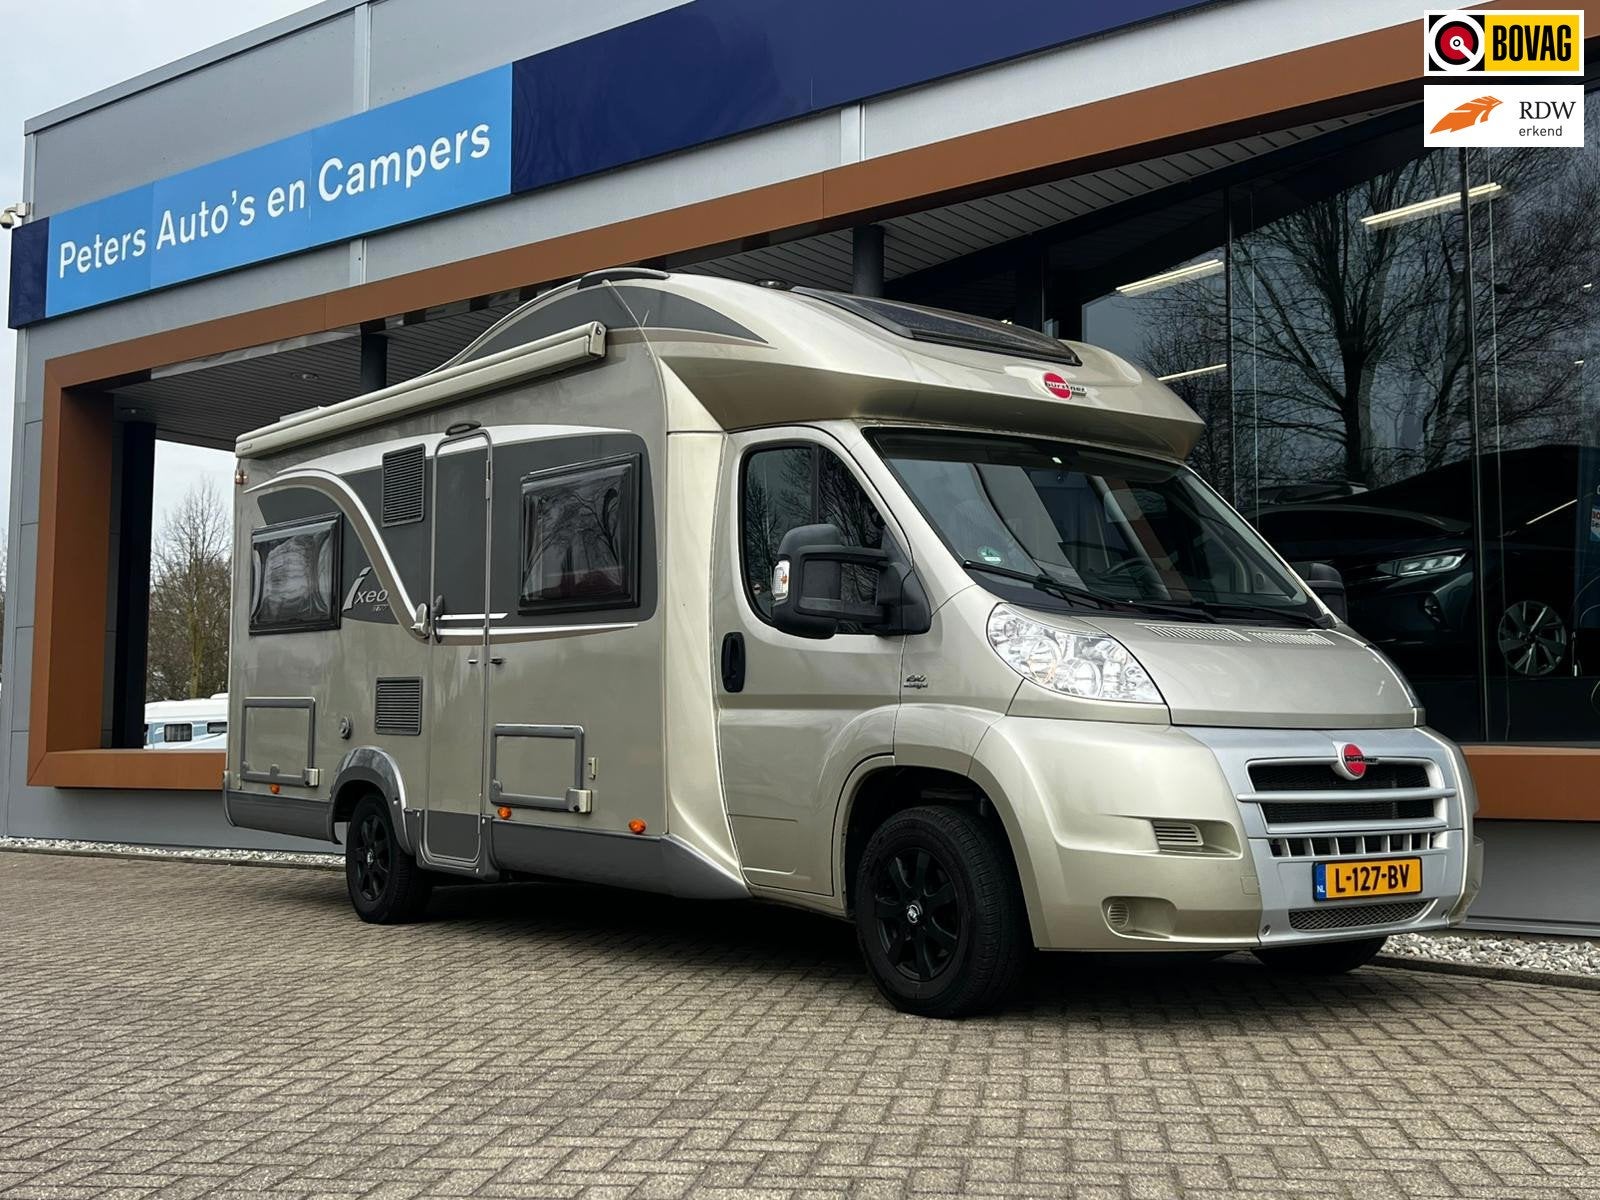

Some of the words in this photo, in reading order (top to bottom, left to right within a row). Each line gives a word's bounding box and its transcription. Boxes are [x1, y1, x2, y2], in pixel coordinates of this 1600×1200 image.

[59, 225, 147, 278] Peters
[155, 189, 256, 250] Auto's
[266, 179, 305, 218] en
[317, 123, 491, 201] Campers
[1316, 884, 1326, 893] NL
[1335, 863, 1410, 893] L-127-BV
